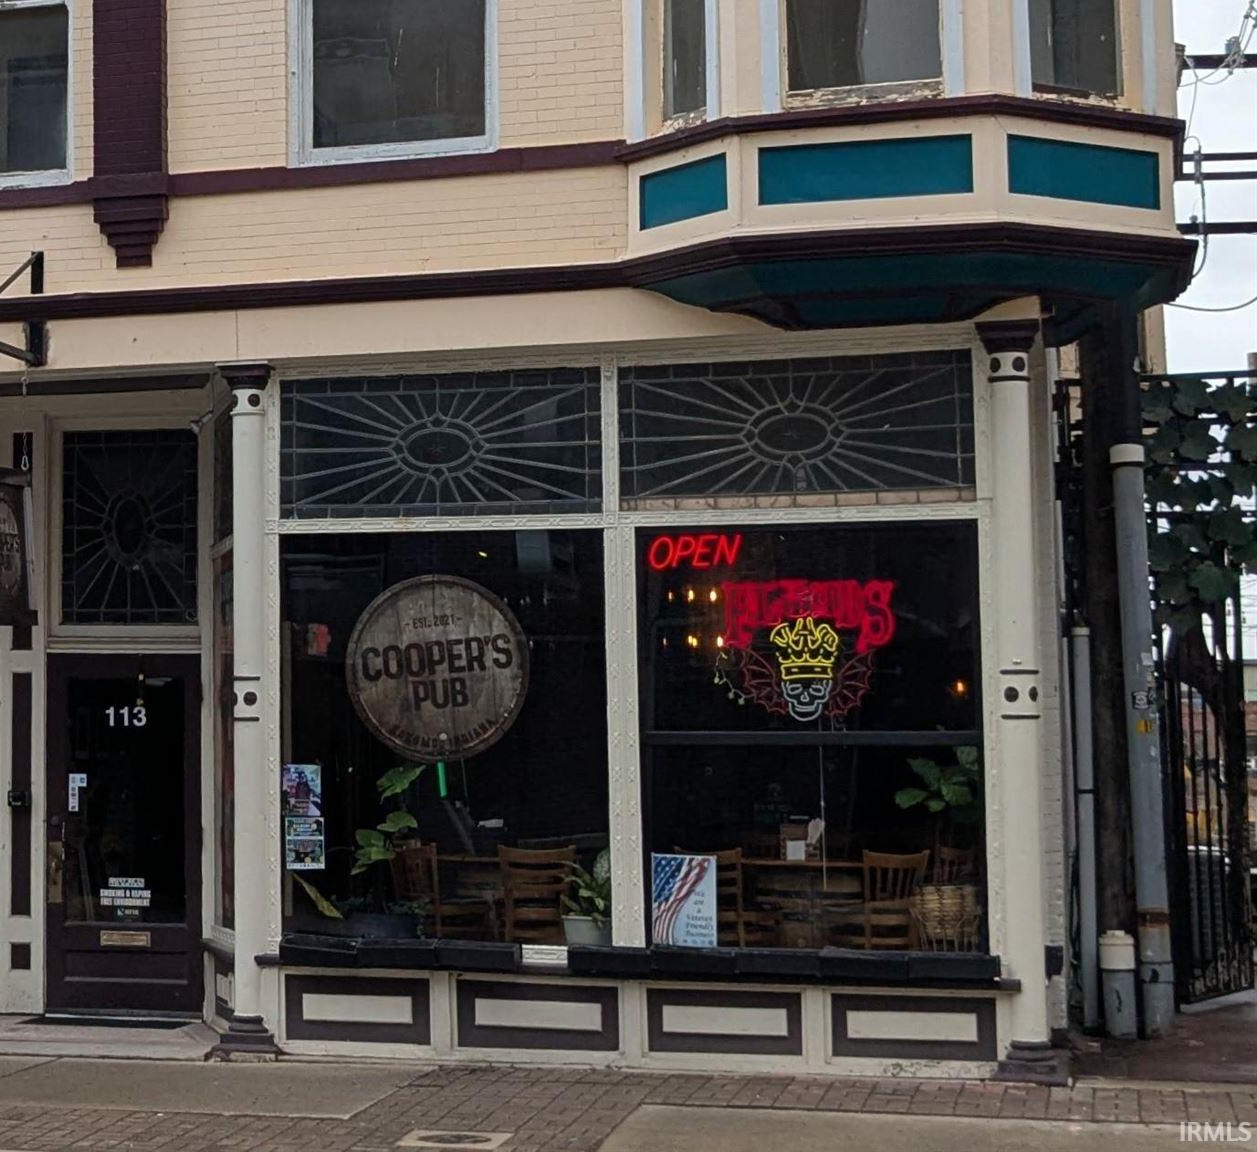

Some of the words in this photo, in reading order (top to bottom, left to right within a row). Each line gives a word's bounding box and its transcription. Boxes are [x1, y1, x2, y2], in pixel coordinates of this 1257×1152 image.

[648, 533, 743, 570] OPEN
[433, 614, 456, 627] 2021
[360, 633, 514, 682] COOPER'S
[411, 677, 471, 711] PUB
[105, 706, 147, 727] 113
